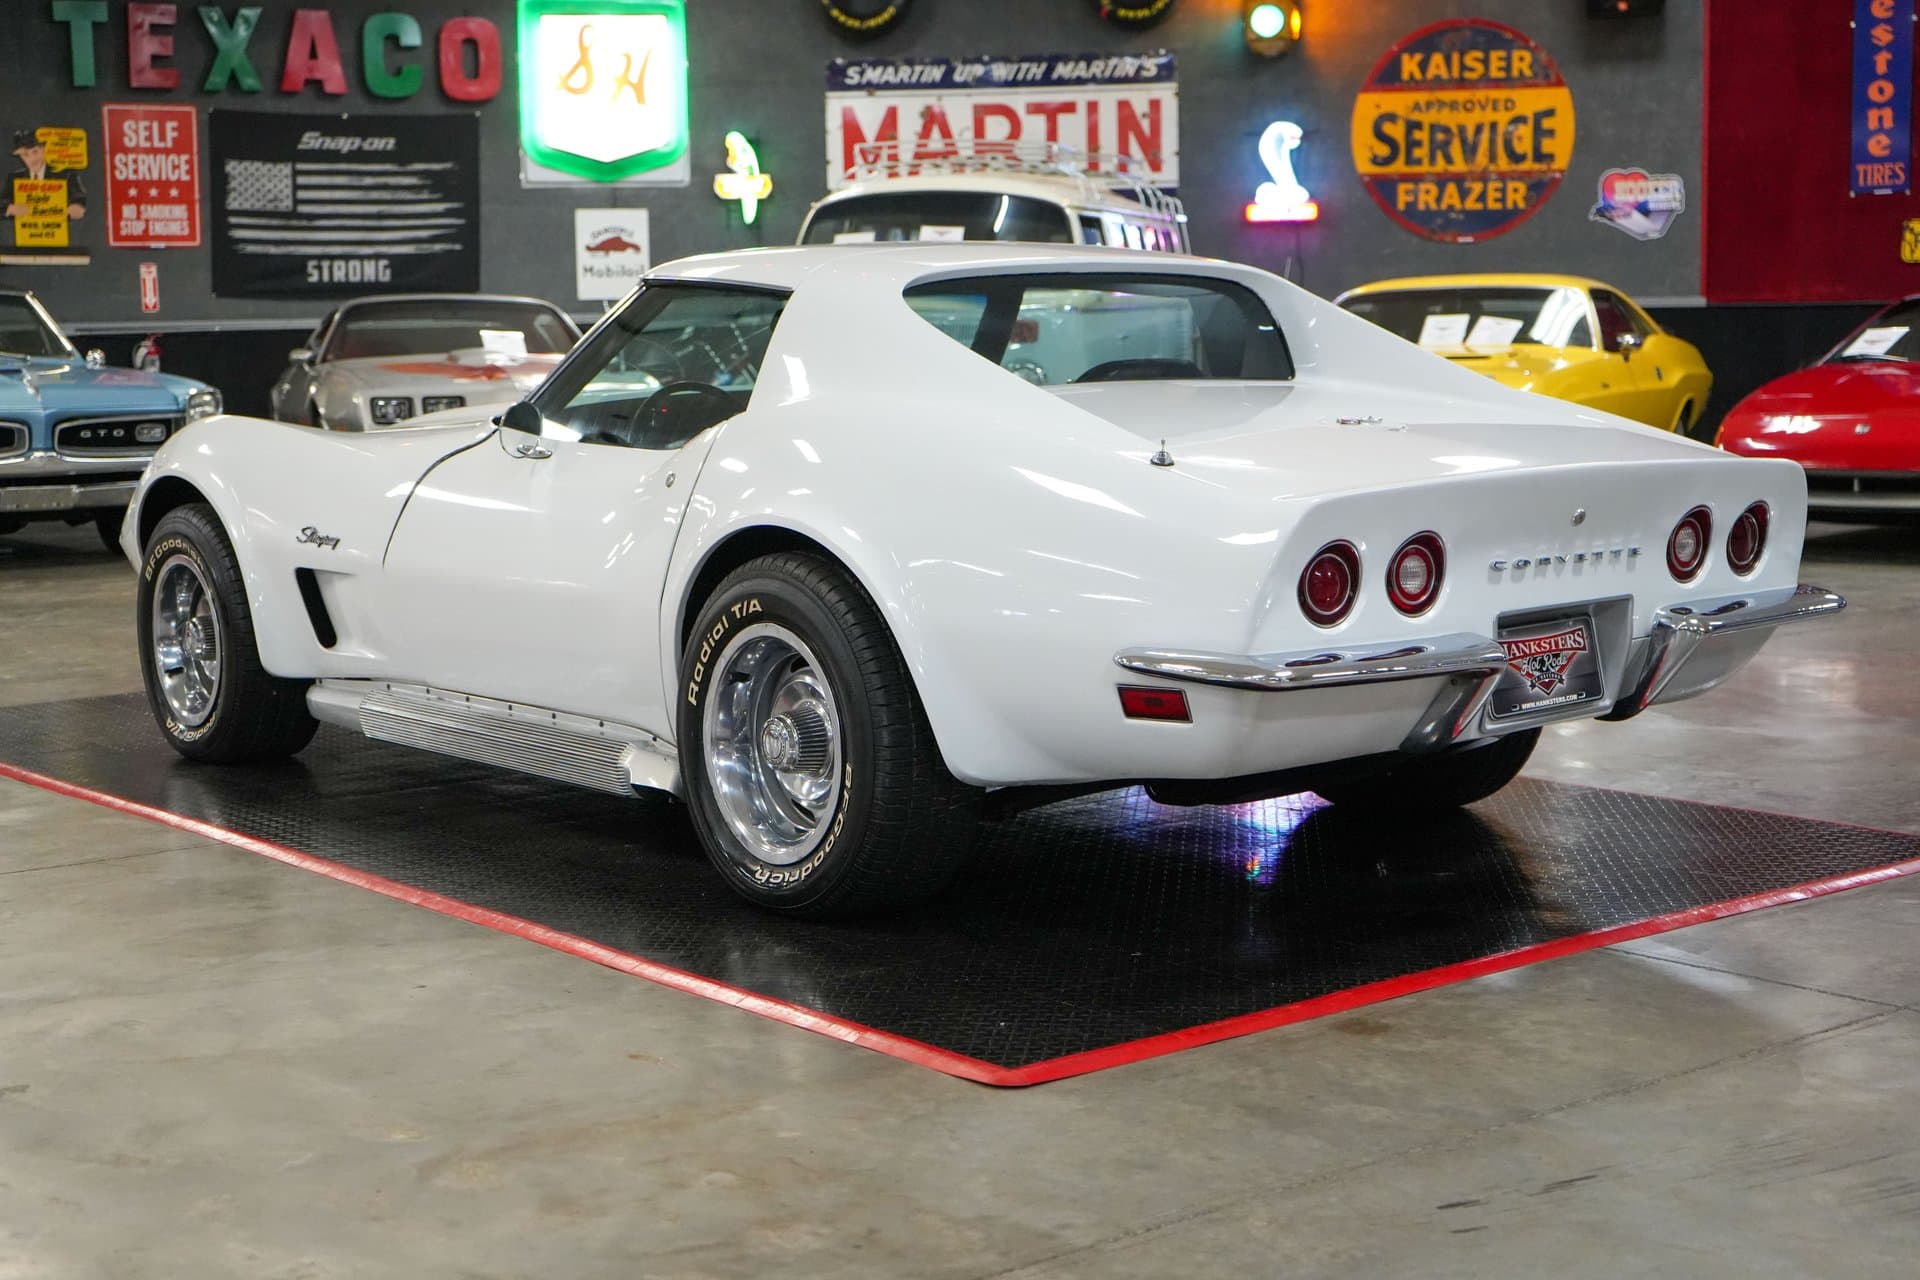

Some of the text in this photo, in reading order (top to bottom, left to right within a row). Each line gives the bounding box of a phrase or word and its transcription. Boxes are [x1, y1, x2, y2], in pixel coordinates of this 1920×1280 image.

[52, 0, 502, 100] TEXACO
[952, 62, 984, 83] UP
[990, 61, 1048, 82] WITH
[1051, 55, 1158, 79] MARTIN'S
[1401, 49, 1533, 81] KAISER
[1411, 98, 1516, 113] APPROVED
[122, 119, 179, 148] SELF
[297, 131, 397, 154] Snap-on
[842, 99, 1163, 180] MARTIN
[1370, 108, 1556, 167] SERVICE
[114, 153, 191, 182] SERVICE
[1856, 162, 1906, 187] TIRES
[1396, 180, 1528, 211] FRAZER
[122, 204, 188, 219] NO SMOKING
[120, 220, 189, 236] STOP ENGINES
[306, 259, 392, 283] STRONG
[80, 428, 125, 439] GTO
[1489, 547, 1642, 571] CORVETTE
[688, 599, 763, 706] Radial T/A
[1521, 653, 1567, 675] Hot Rods
[754, 761, 852, 888] BFGoodrich
